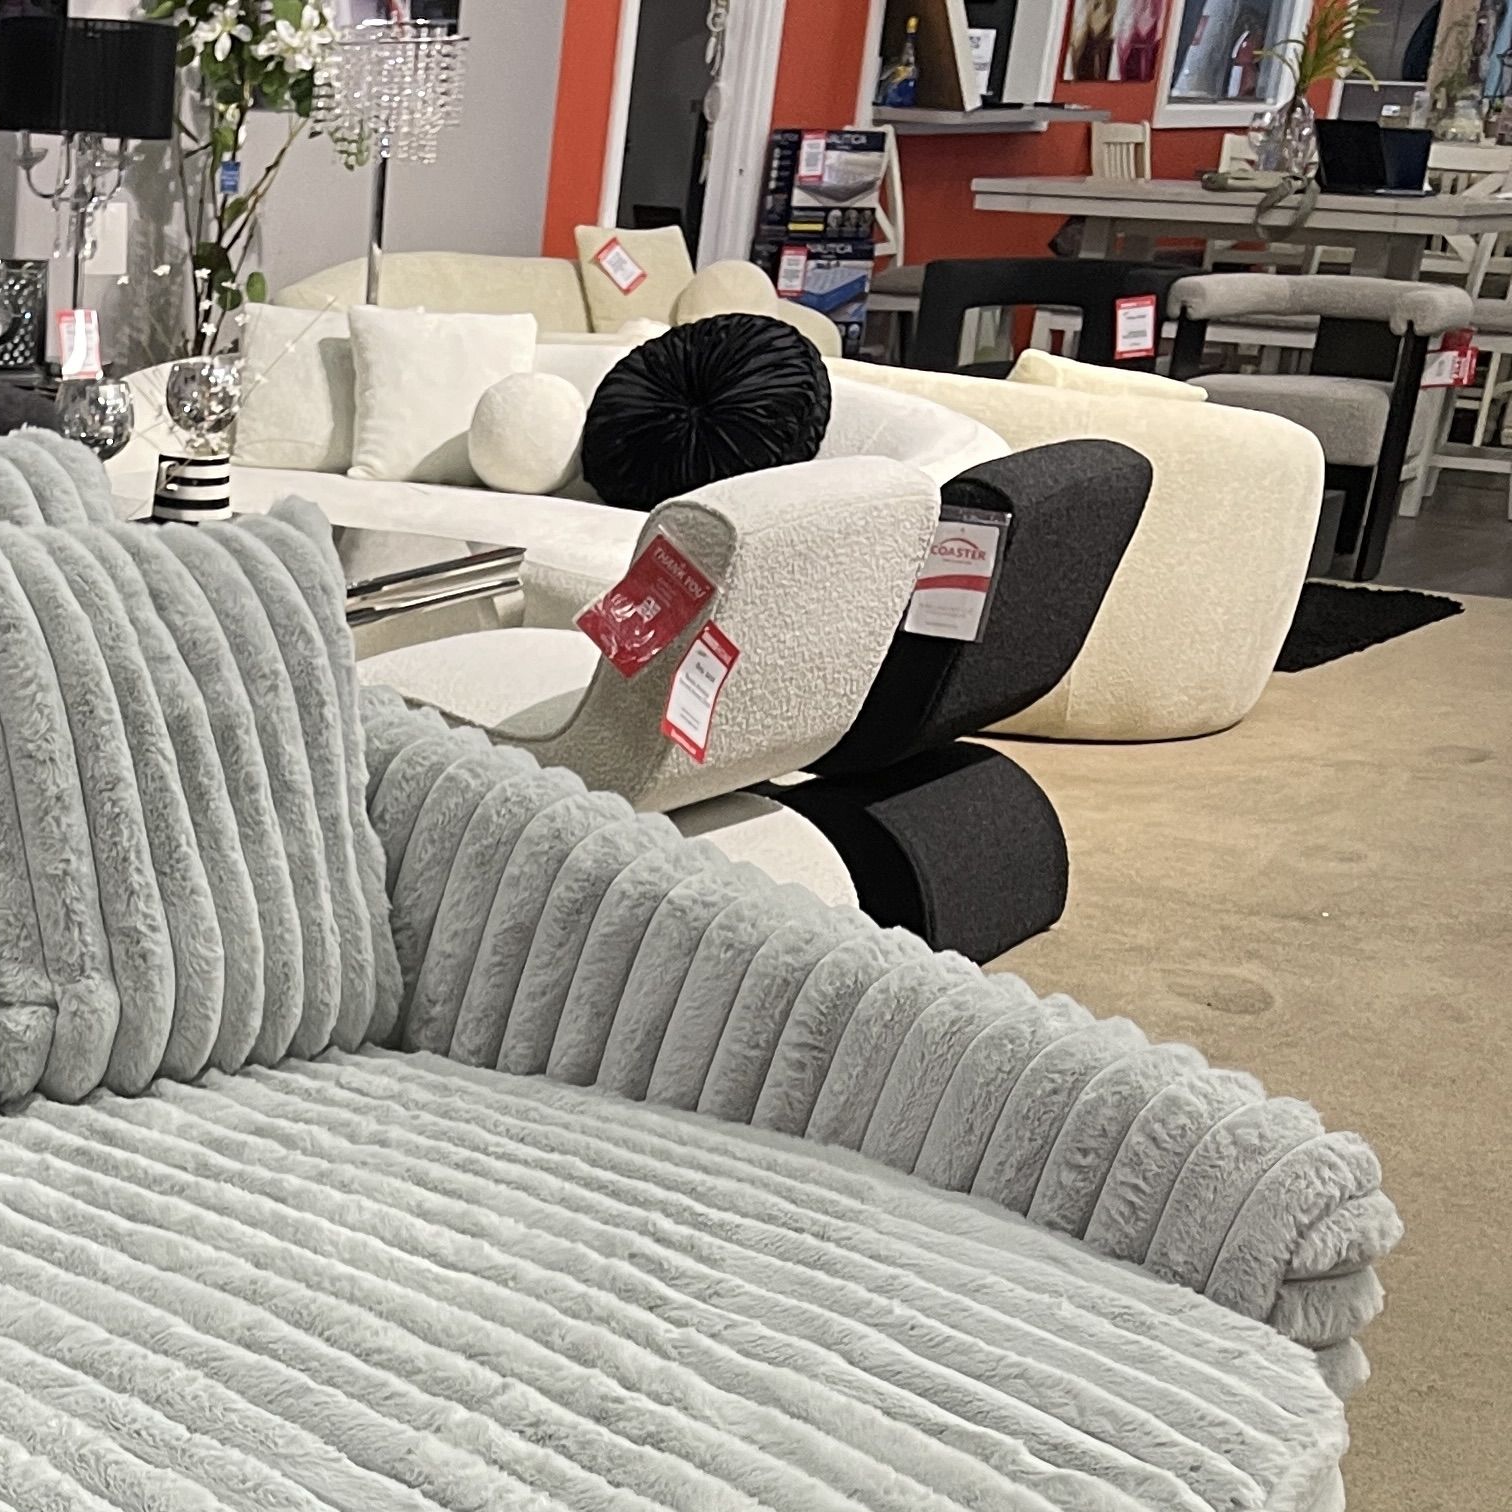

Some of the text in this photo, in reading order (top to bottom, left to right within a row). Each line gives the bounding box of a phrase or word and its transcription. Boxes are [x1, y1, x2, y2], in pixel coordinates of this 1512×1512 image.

[930, 545, 986, 560] COASTER
[654, 547, 687, 579] THANK
[683, 575, 706, 598] YOU
